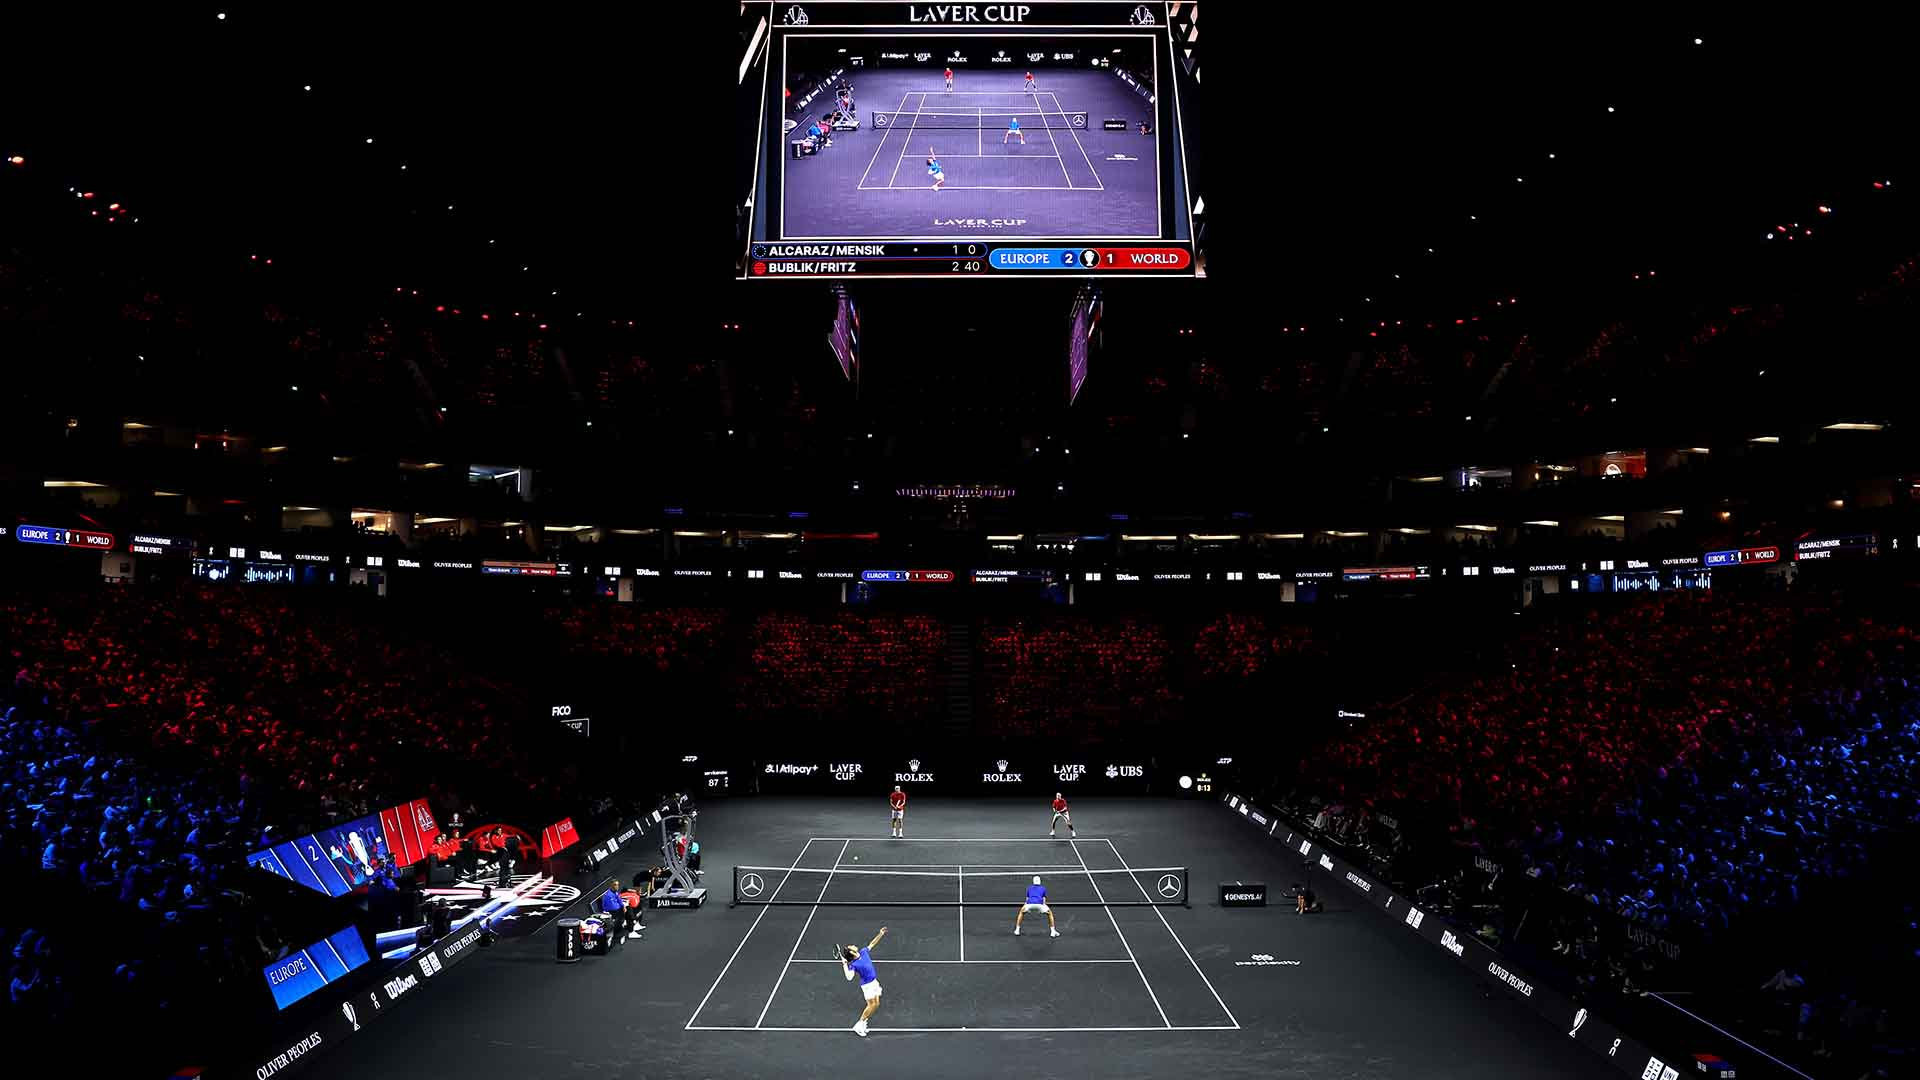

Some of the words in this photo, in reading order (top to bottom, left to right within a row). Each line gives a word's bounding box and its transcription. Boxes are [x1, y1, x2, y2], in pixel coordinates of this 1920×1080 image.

[911, 6, 980, 21] LAVER
[984, 6, 1030, 21] CUP
[769, 245, 884, 256] ALCARAZ/MENSIK
[953, 245, 957, 254] 1
[969, 245, 975, 254] 0
[1001, 254, 1049, 264] EUROPE
[1065, 254, 1074, 265] 2
[1107, 254, 1112, 263] 1
[1131, 254, 1178, 264] WORLD
[769, 262, 856, 273] BUBLIK/FRITZ
[953, 262, 959, 271] 2
[965, 262, 979, 271] 40
[22, 527, 48, 542] EUROPE
[87, 536, 109, 544] WORLD
[1708, 555, 1726, 563] EUROPE
[866, 571, 889, 580] EUROPE
[552, 706, 571, 716] FICO
[830, 764, 862, 773] LAVER
[1054, 765, 1086, 773] LAVER
[1120, 766, 1143, 776] UBS
[896, 773, 933, 781] ROLEX
[984, 774, 1021, 782] ROLEX
[1440, 930, 1464, 957] Wilson
[270, 957, 307, 985] EUROPE
[1487, 961, 1509, 982] OLIVER
[1507, 973, 1534, 998] PEOPLES
[384, 974, 418, 1000] Wilson
[256, 1053, 289, 1080] OLIVER
[286, 1031, 322, 1064] PEOPLES
